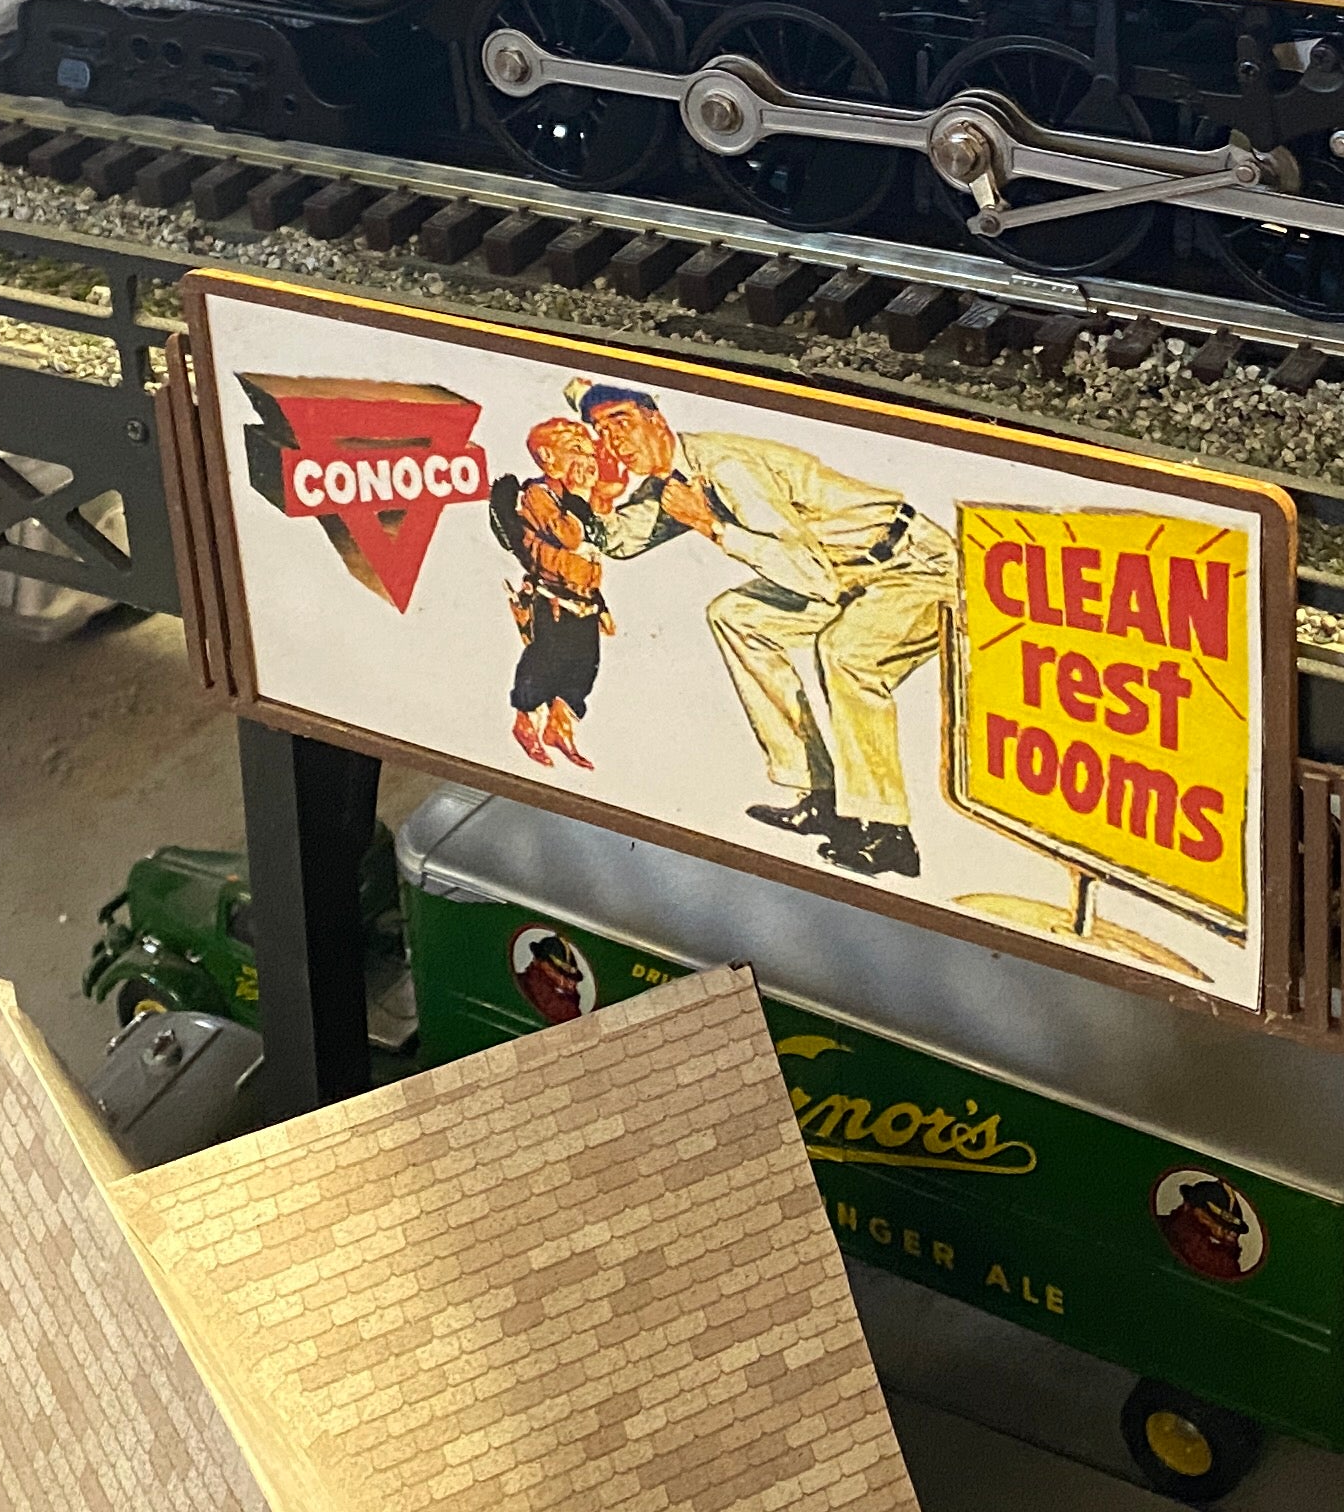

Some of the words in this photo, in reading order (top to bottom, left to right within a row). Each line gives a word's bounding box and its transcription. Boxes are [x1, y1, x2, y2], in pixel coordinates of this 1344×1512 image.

[293, 455, 480, 507] CONOCO
[983, 541, 1230, 661] CLEAN
[1020, 640, 1192, 751] rest
[986, 713, 1224, 863] rooms
[791, 1087, 1011, 1166] nor's
[836, 1200, 955, 1271] NGER
[985, 1263, 1066, 1316] ALE
